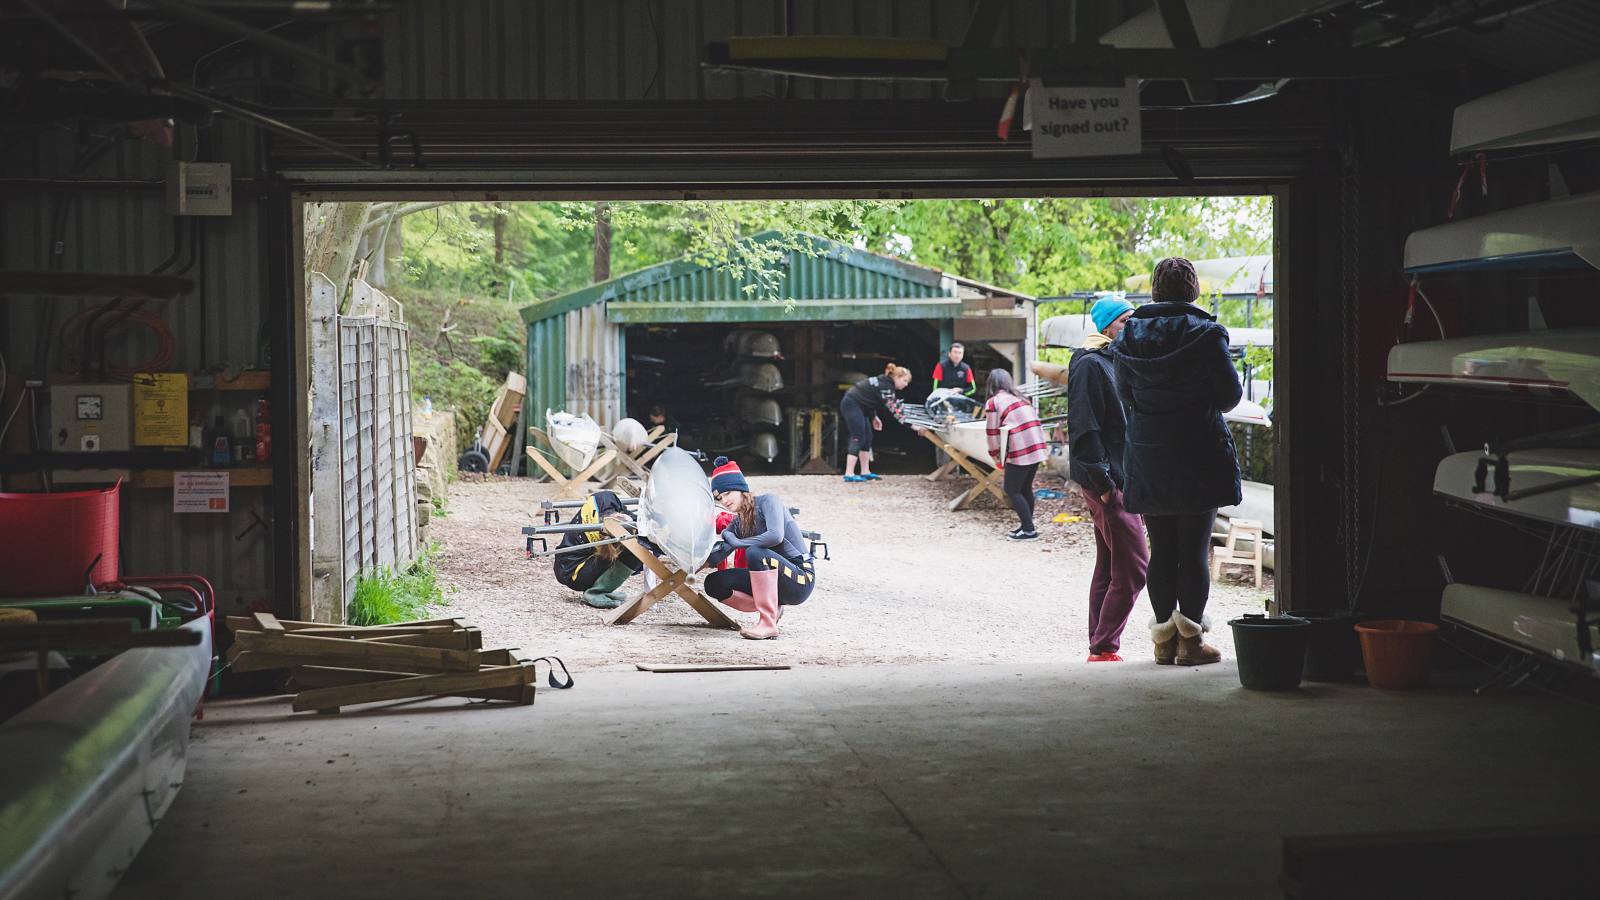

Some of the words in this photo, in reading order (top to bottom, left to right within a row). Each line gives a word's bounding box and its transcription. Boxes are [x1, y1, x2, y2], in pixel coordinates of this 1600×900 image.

[1048, 97, 1087, 110] Have
[1090, 97, 1119, 111] you
[1040, 120, 1090, 138] signed
[1094, 118, 1129, 133] out?
